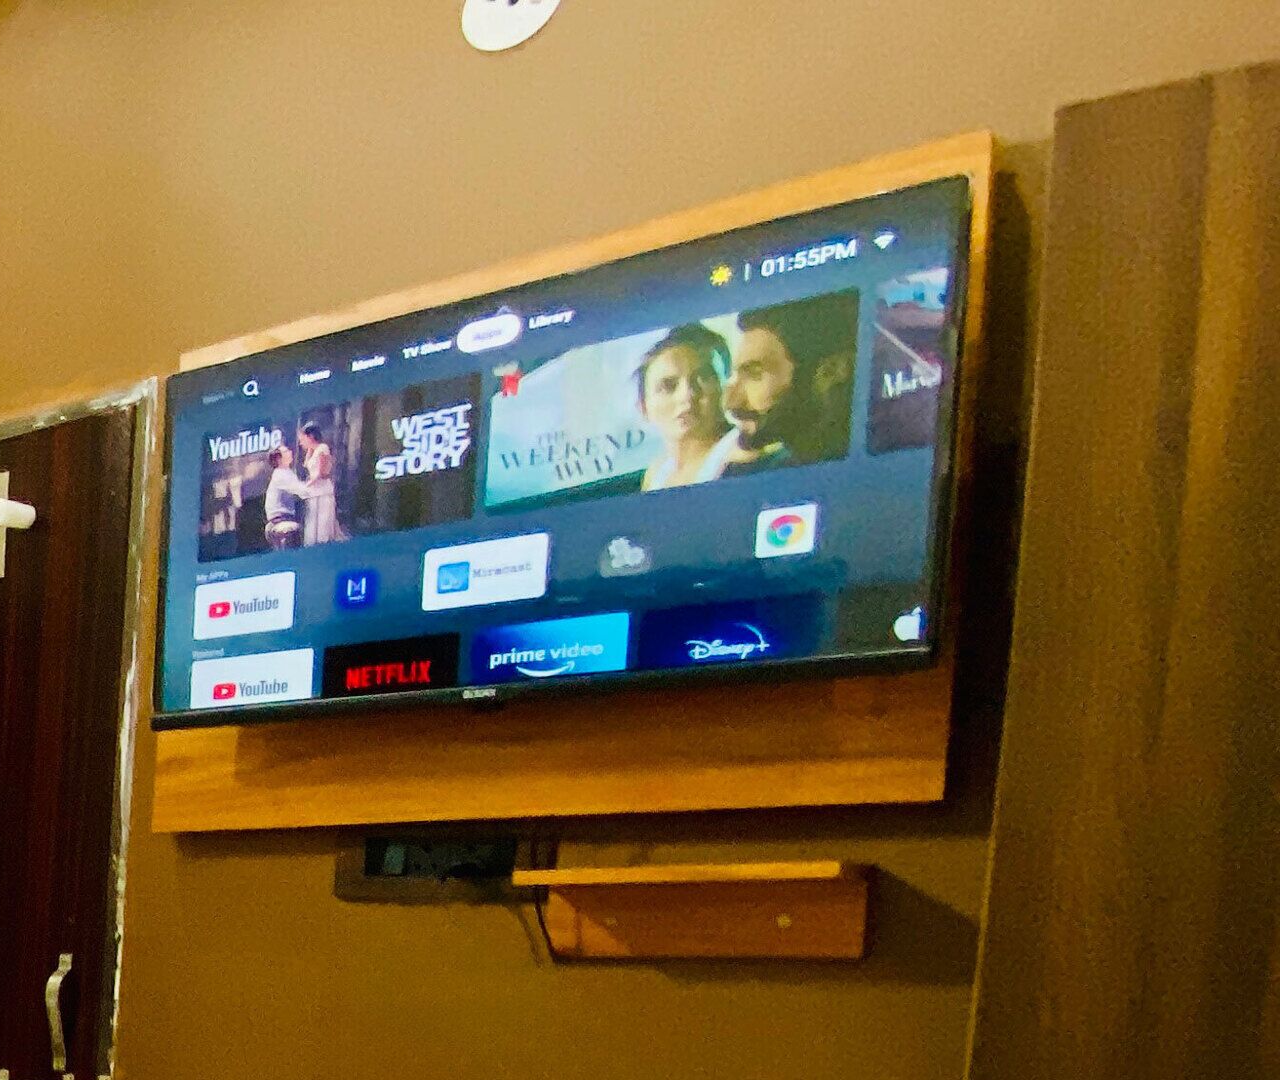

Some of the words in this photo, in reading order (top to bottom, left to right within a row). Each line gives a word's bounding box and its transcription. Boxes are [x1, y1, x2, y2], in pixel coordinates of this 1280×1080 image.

[760, 238, 857, 278] 01:55PM
[391, 402, 472, 441] WEST
[208, 426, 283, 463] YouTube
[402, 426, 471, 453] SIDE
[500, 427, 646, 470] WEEKEND
[374, 438, 471, 481] STORY
[233, 596, 279, 615] YouTube
[489, 647, 547, 670] prime
[549, 642, 604, 661] video
[239, 679, 289, 698] YouTube
[345, 659, 432, 692] NETFLIX
